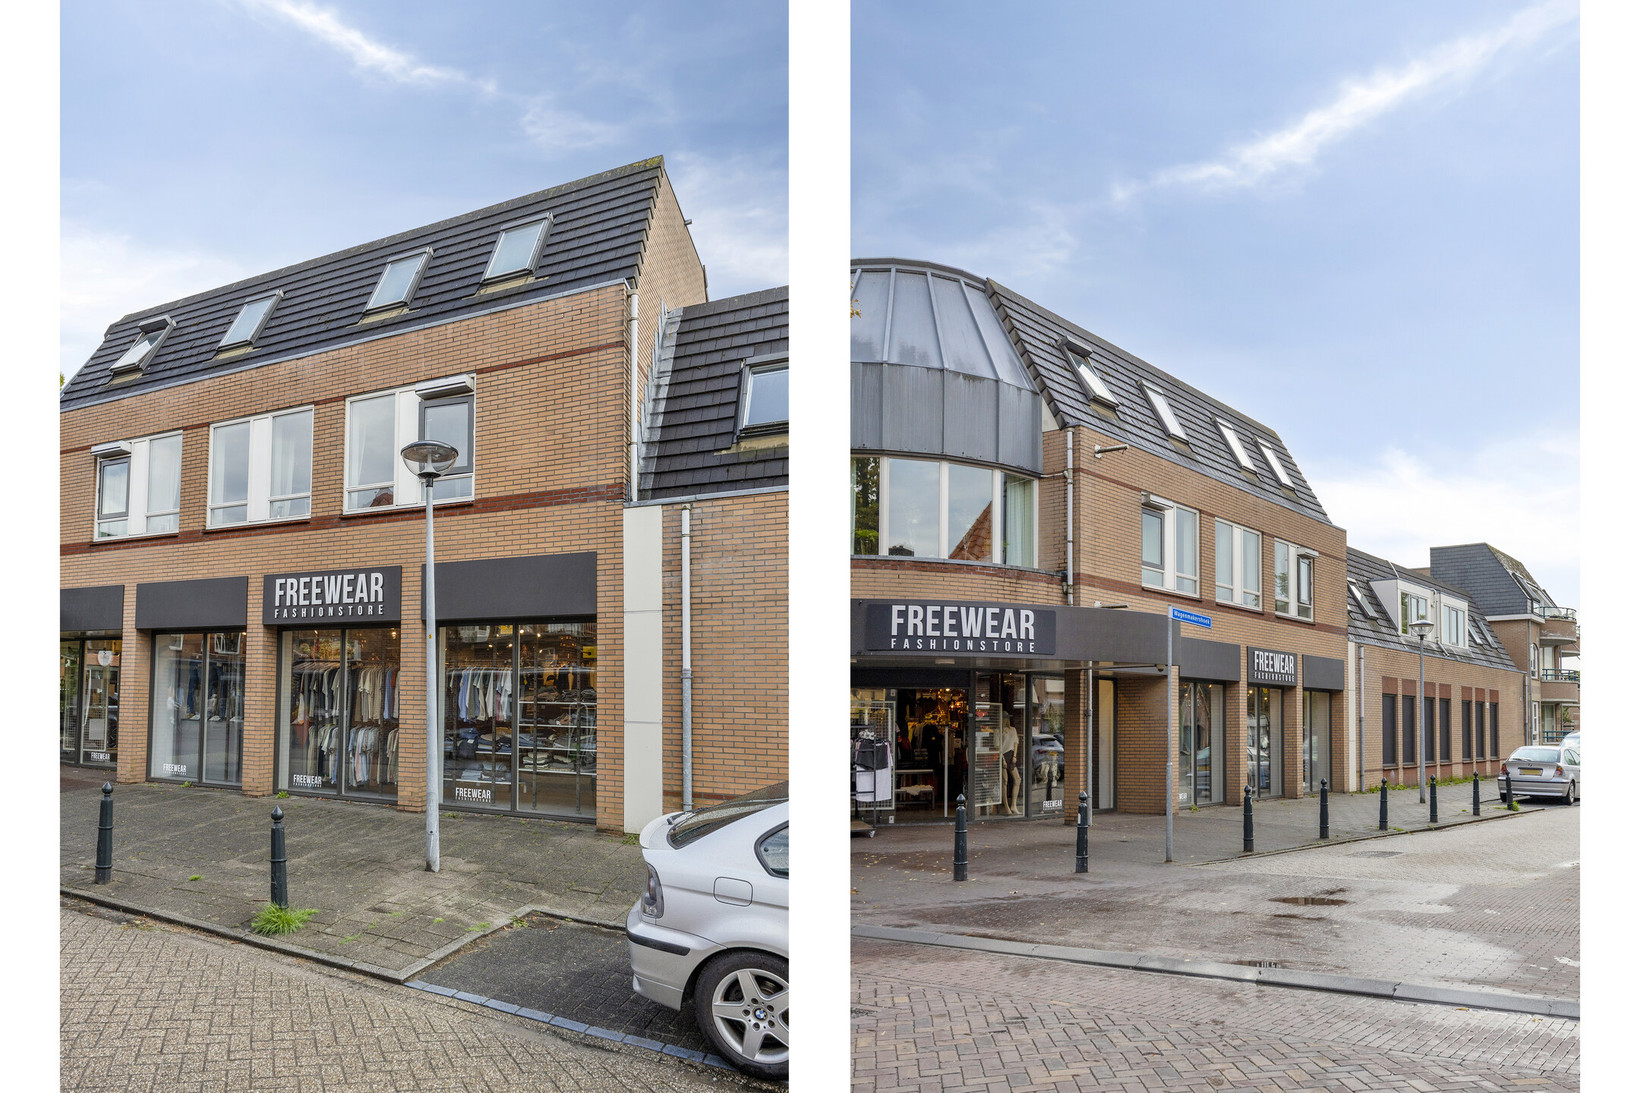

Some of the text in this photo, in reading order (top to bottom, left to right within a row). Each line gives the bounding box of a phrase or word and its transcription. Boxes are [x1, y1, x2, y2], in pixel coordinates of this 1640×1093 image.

[275, 573, 384, 607] FREEWEAR
[274, 604, 384, 619] FASHIONSTORE
[1173, 609, 1211, 625] Wagenmakershoek
[891, 604, 1035, 640] FREEWEAR
[891, 638, 1035, 653] FASHIONSTORE
[1254, 650, 1295, 675] FREEWEAR
[1254, 671, 1295, 682] FASHIONSTORE
[91, 751, 110, 760] FREEWEAR
[163, 763, 187, 773] FREEWEAR
[293, 774, 322, 785] FREEWEAR
[455, 787, 491, 799] FREEWEAR
[1042, 799, 1063, 808] FREEWEAR
